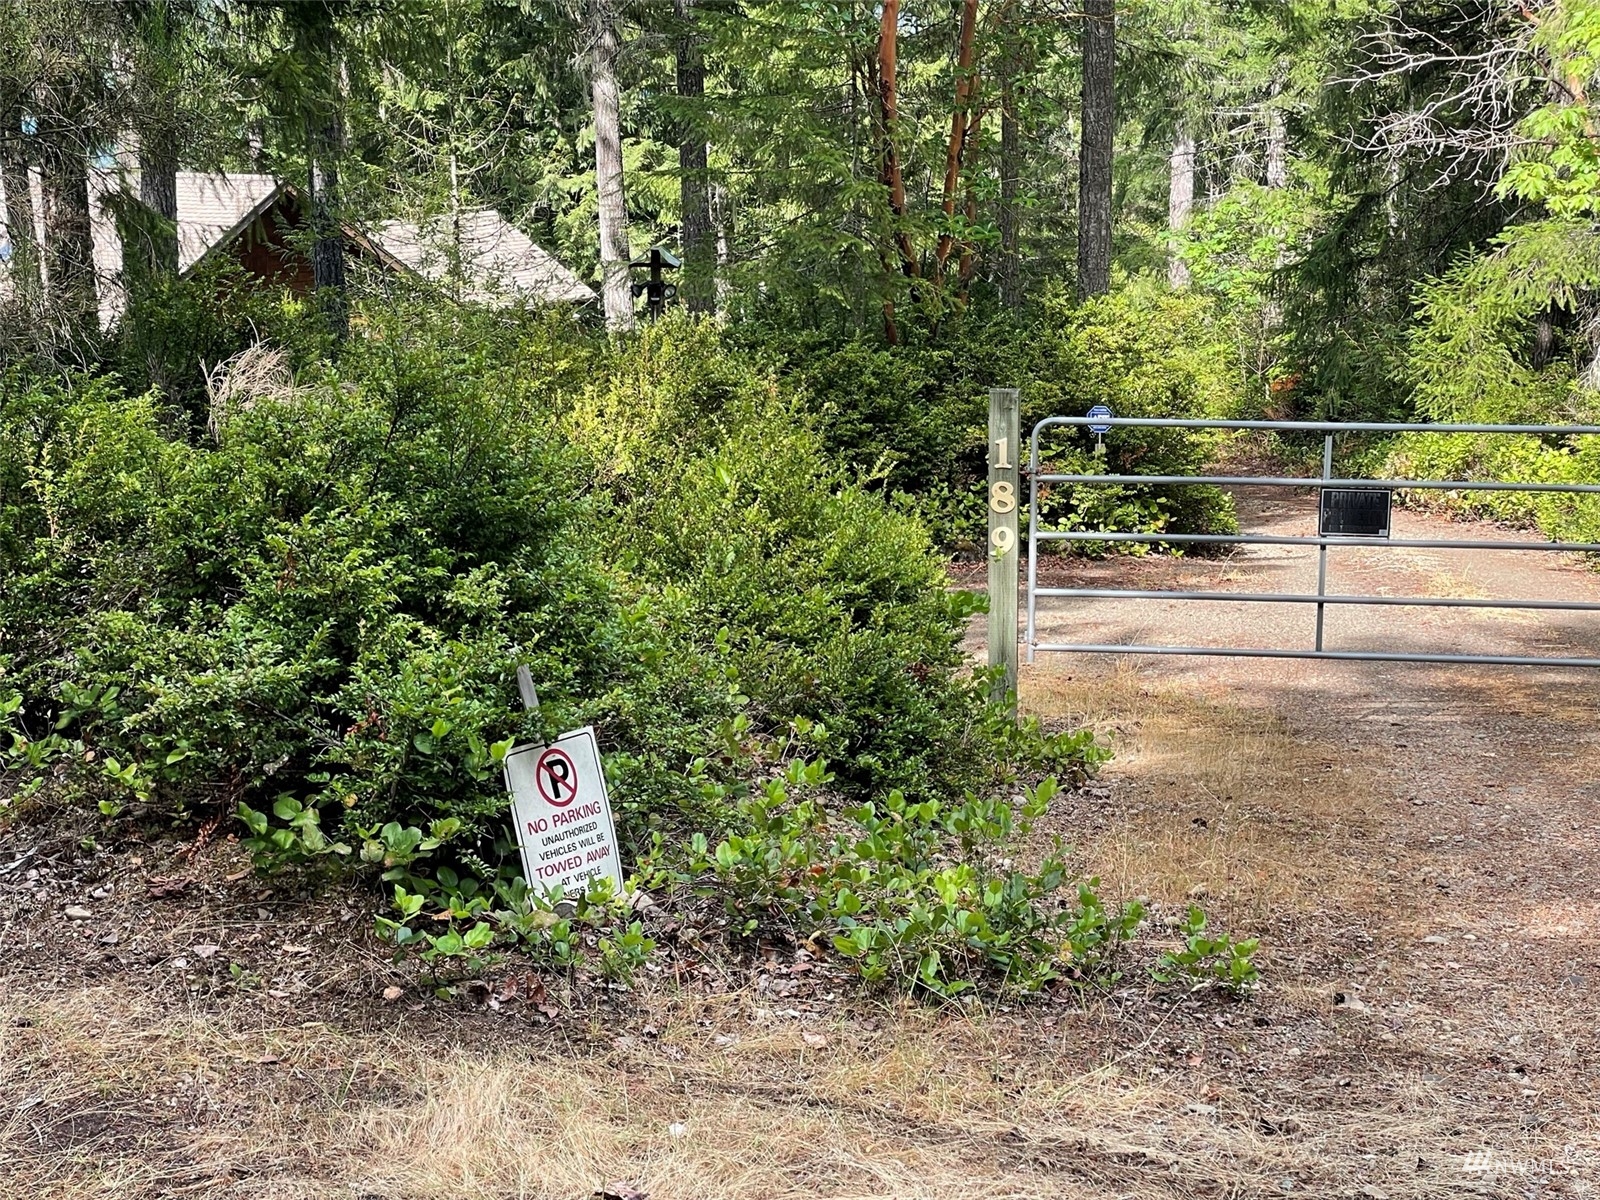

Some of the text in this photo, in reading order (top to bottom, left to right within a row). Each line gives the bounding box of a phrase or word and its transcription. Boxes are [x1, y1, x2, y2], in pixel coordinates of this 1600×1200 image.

[990, 437, 1016, 556] 189
[1330, 491, 1381, 508] PRIVATE
[546, 758, 569, 799] P
[527, 801, 602, 835] NO PARKING
[539, 832, 605, 861] VEHICLES WILL BE
[541, 821, 598, 847] UNAUTHORIZED
[535, 845, 611, 880] TOWED AWAY
[561, 876, 571, 886] AT
